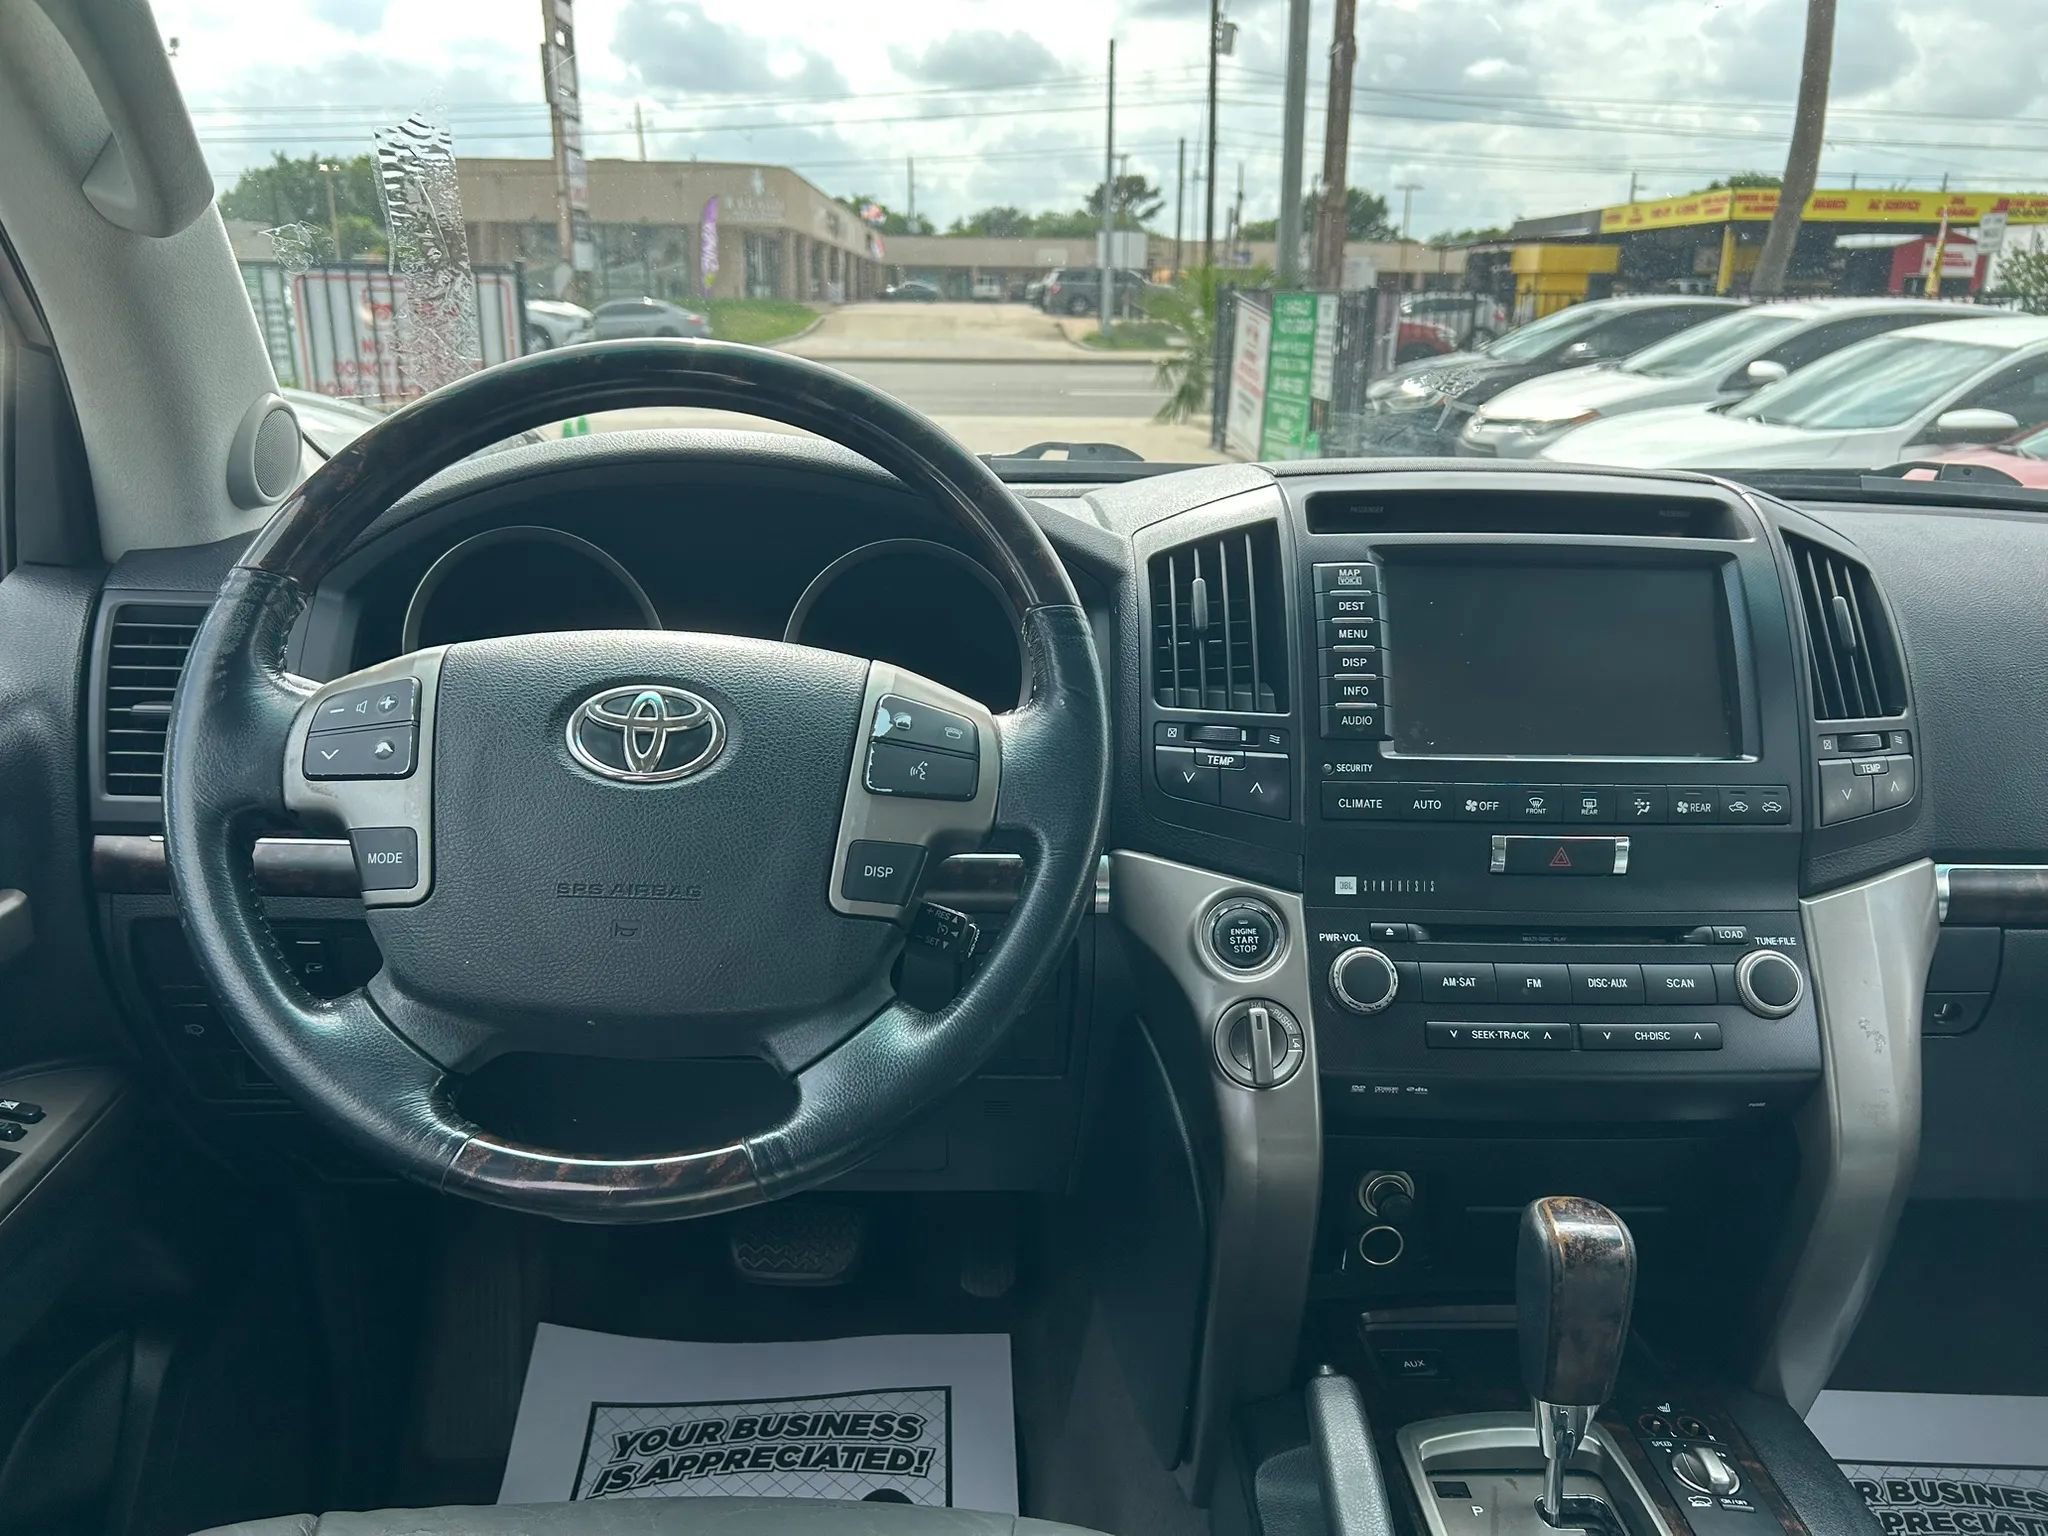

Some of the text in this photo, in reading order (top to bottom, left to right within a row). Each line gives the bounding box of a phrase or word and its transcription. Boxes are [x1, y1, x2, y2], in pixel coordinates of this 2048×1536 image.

[1338, 568, 1361, 577] MAP
[1338, 601, 1365, 611] DEST
[1338, 629, 1368, 639] MENU
[1342, 657, 1367, 668] DISP
[1343, 686, 1369, 696] INFO
[1341, 715, 1373, 726] AUDIO
[1208, 754, 1234, 766] TEMP
[1336, 763, 1373, 773] SECURITY
[1861, 763, 1881, 774] TEMP
[1338, 798, 1383, 809] CLIMATE
[1413, 800, 1442, 810] AUTO
[1479, 801, 1500, 812] OFF
[1690, 802, 1711, 813] REAR
[1525, 807, 1547, 815] FRONT
[1581, 808, 1598, 816] REAR
[367, 852, 403, 864] MODE
[864, 864, 893, 878] DISP
[610, 883, 702, 898] AIRBAG
[1230, 928, 1257, 936] ENGINE
[1718, 930, 1744, 939] LOAD
[1229, 936, 1259, 944] START
[1233, 945, 1257, 953] STOP
[1526, 978, 1542, 989] FM
[1666, 979, 1695, 989] SCAN
[1292, 1038, 1301, 1049] L4
[1403, 1358, 1425, 1369] AUX
[612, 1411, 926, 1460] YOUR BUSINESS
[589, 1444, 935, 1496] IS APPRECIATED!
[1471, 1506, 1484, 1517] P
